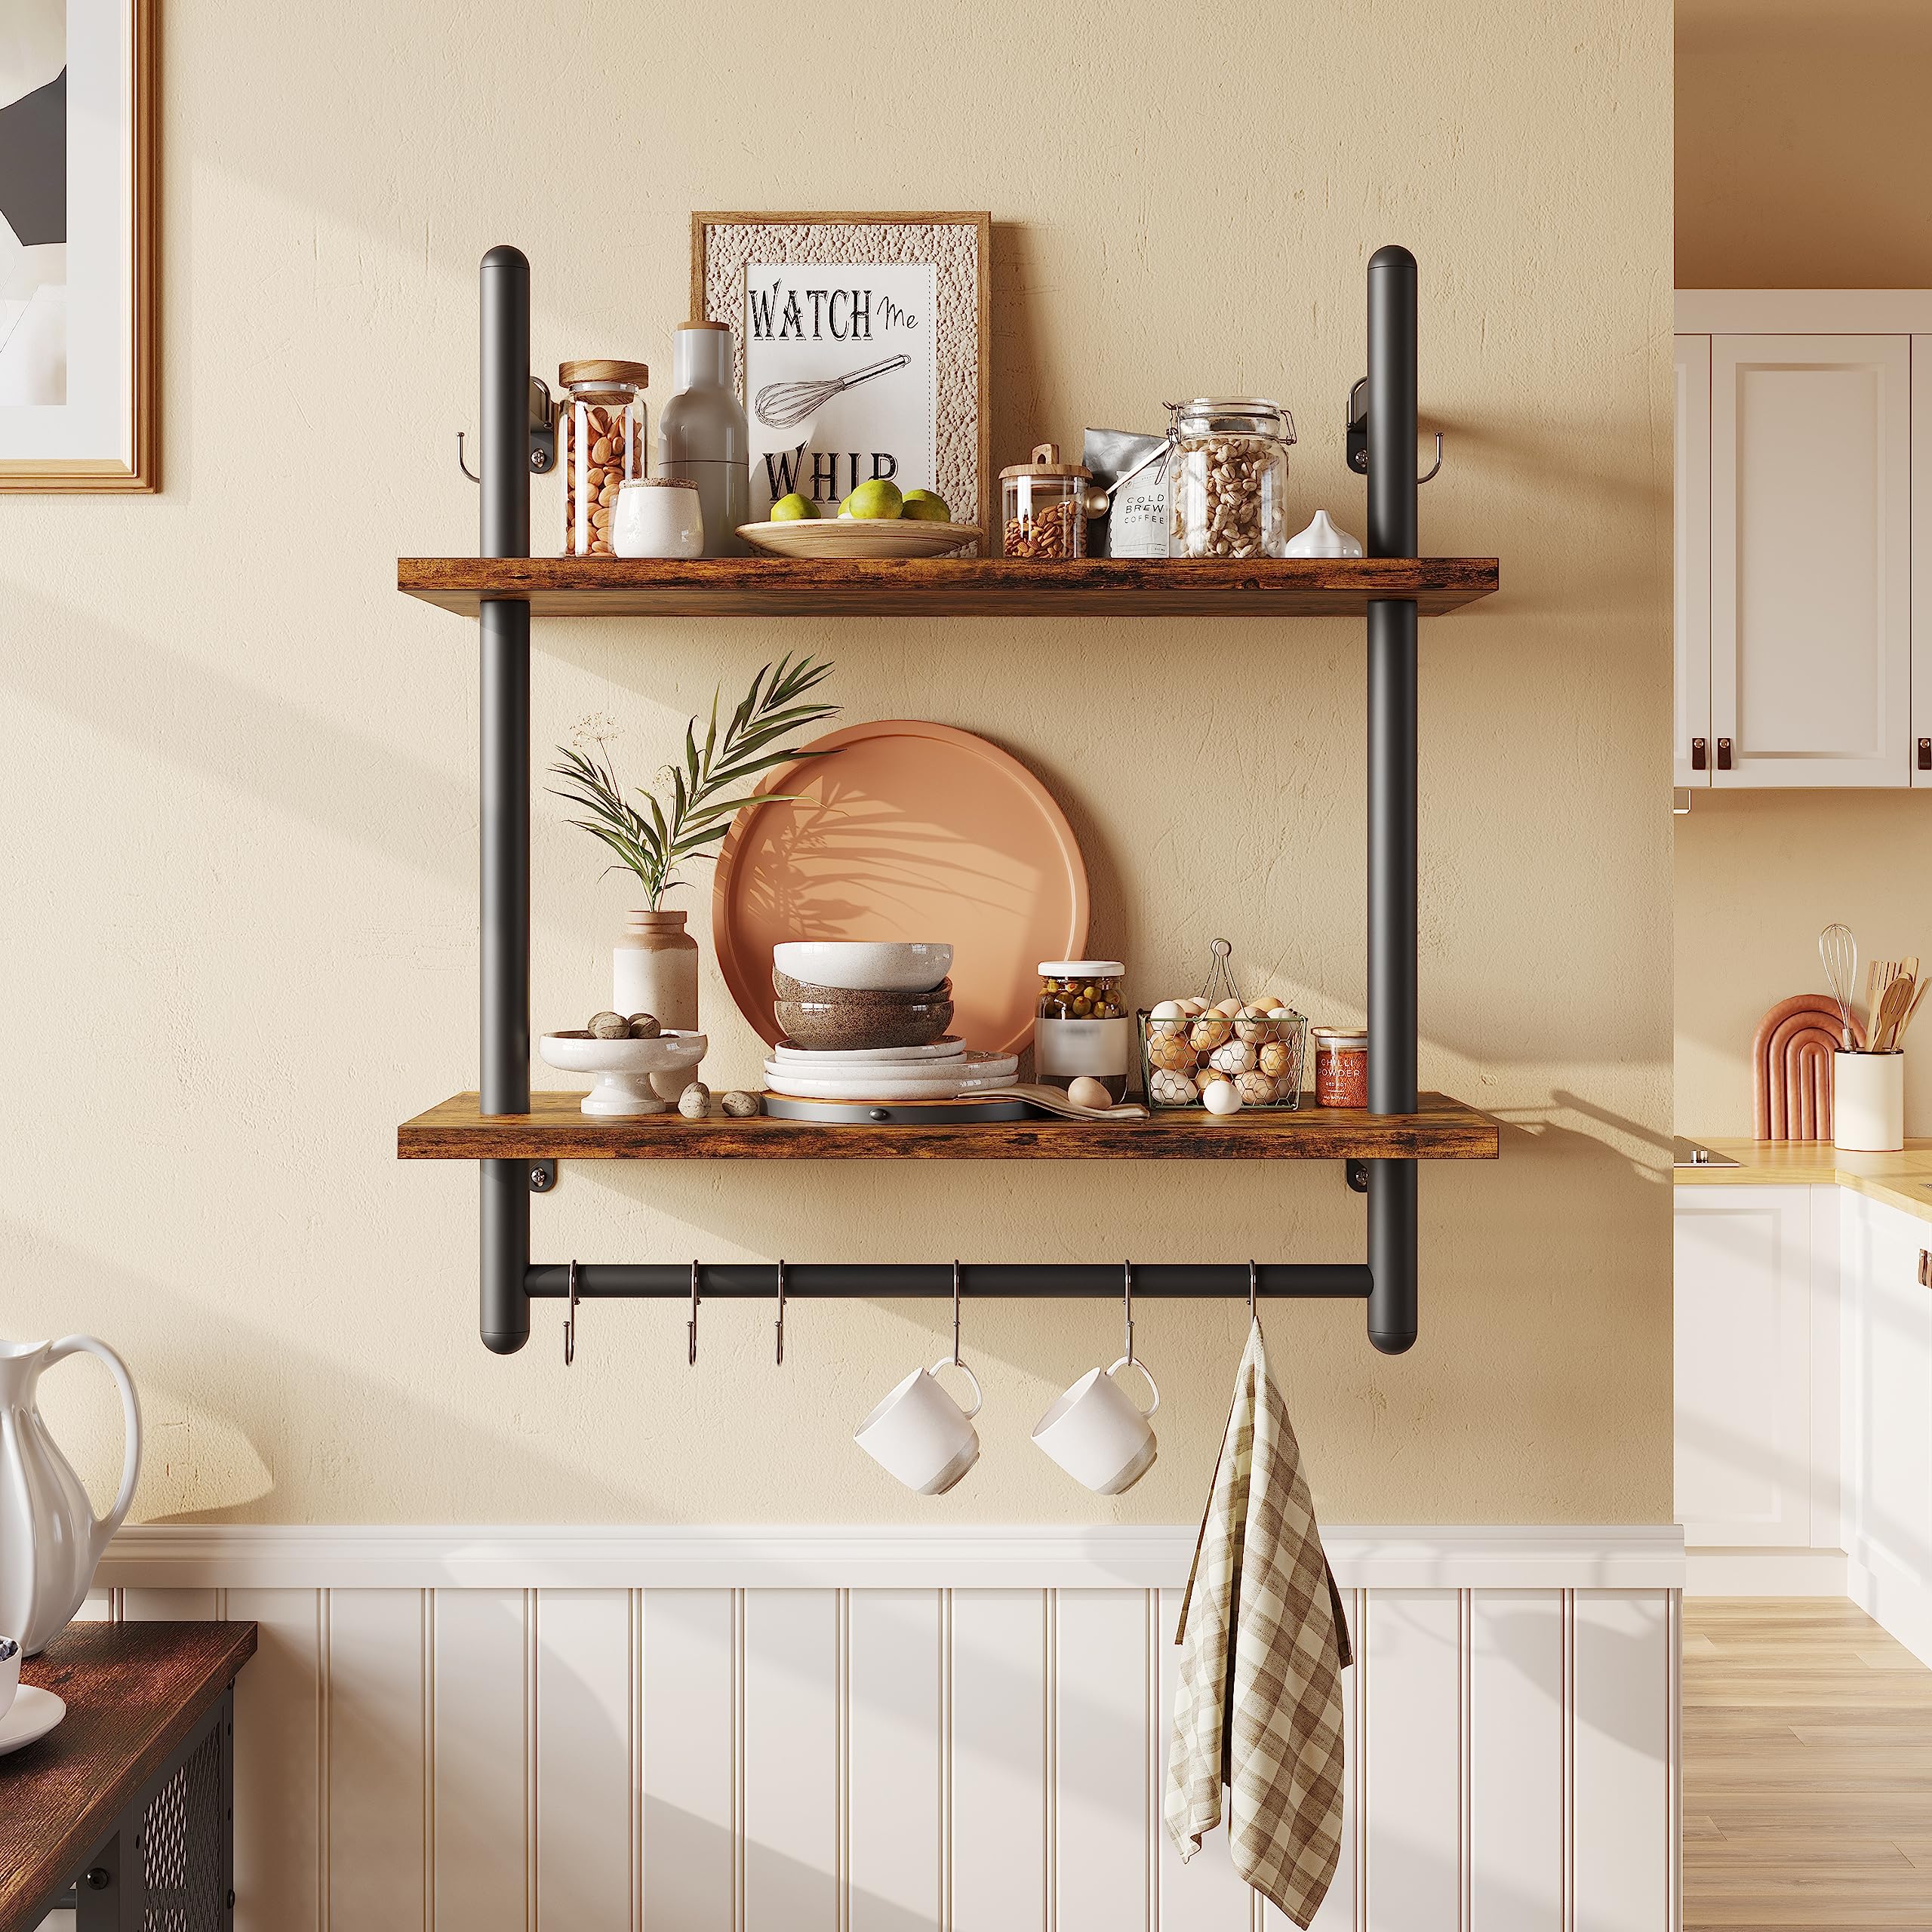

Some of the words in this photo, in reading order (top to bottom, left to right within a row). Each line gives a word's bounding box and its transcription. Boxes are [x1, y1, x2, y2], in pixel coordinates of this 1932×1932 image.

[748, 278, 874, 342] WATCH
[876, 296, 919, 331] Me
[762, 440, 899, 503] WHIP
[1127, 494, 1164, 503] COLD
[1125, 504, 1164, 514] BREW
[1124, 515, 1164, 525] COFFEE
[1321, 1058, 1353, 1067] CHILLI
[1318, 1069, 1360, 1077] POWDER
